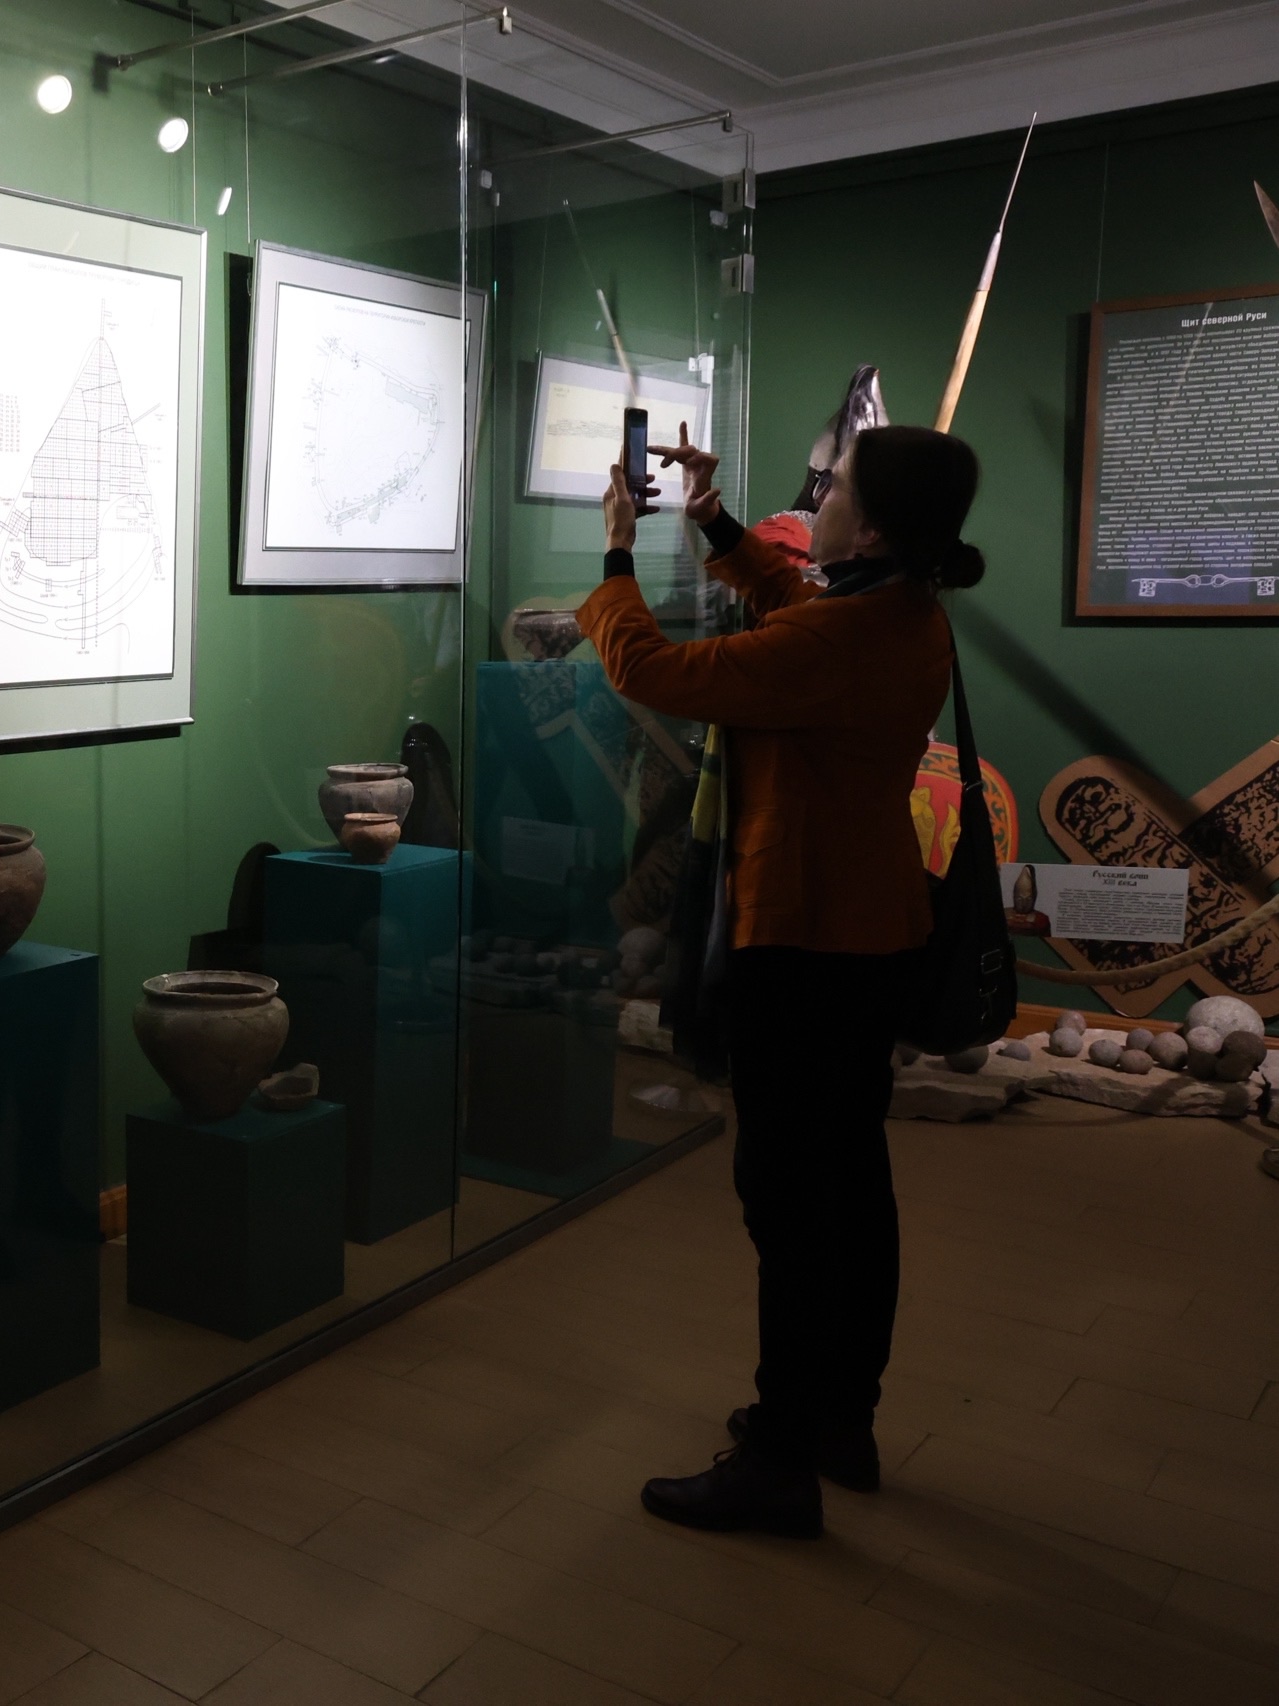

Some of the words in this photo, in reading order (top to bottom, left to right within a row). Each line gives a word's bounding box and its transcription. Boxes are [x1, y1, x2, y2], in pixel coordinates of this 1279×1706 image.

[1181, 319, 1199, 327] Щит
[1202, 313, 1243, 325] северной
[1246, 312, 1267, 321] Руси
[1092, 869, 1126, 878] Русский
